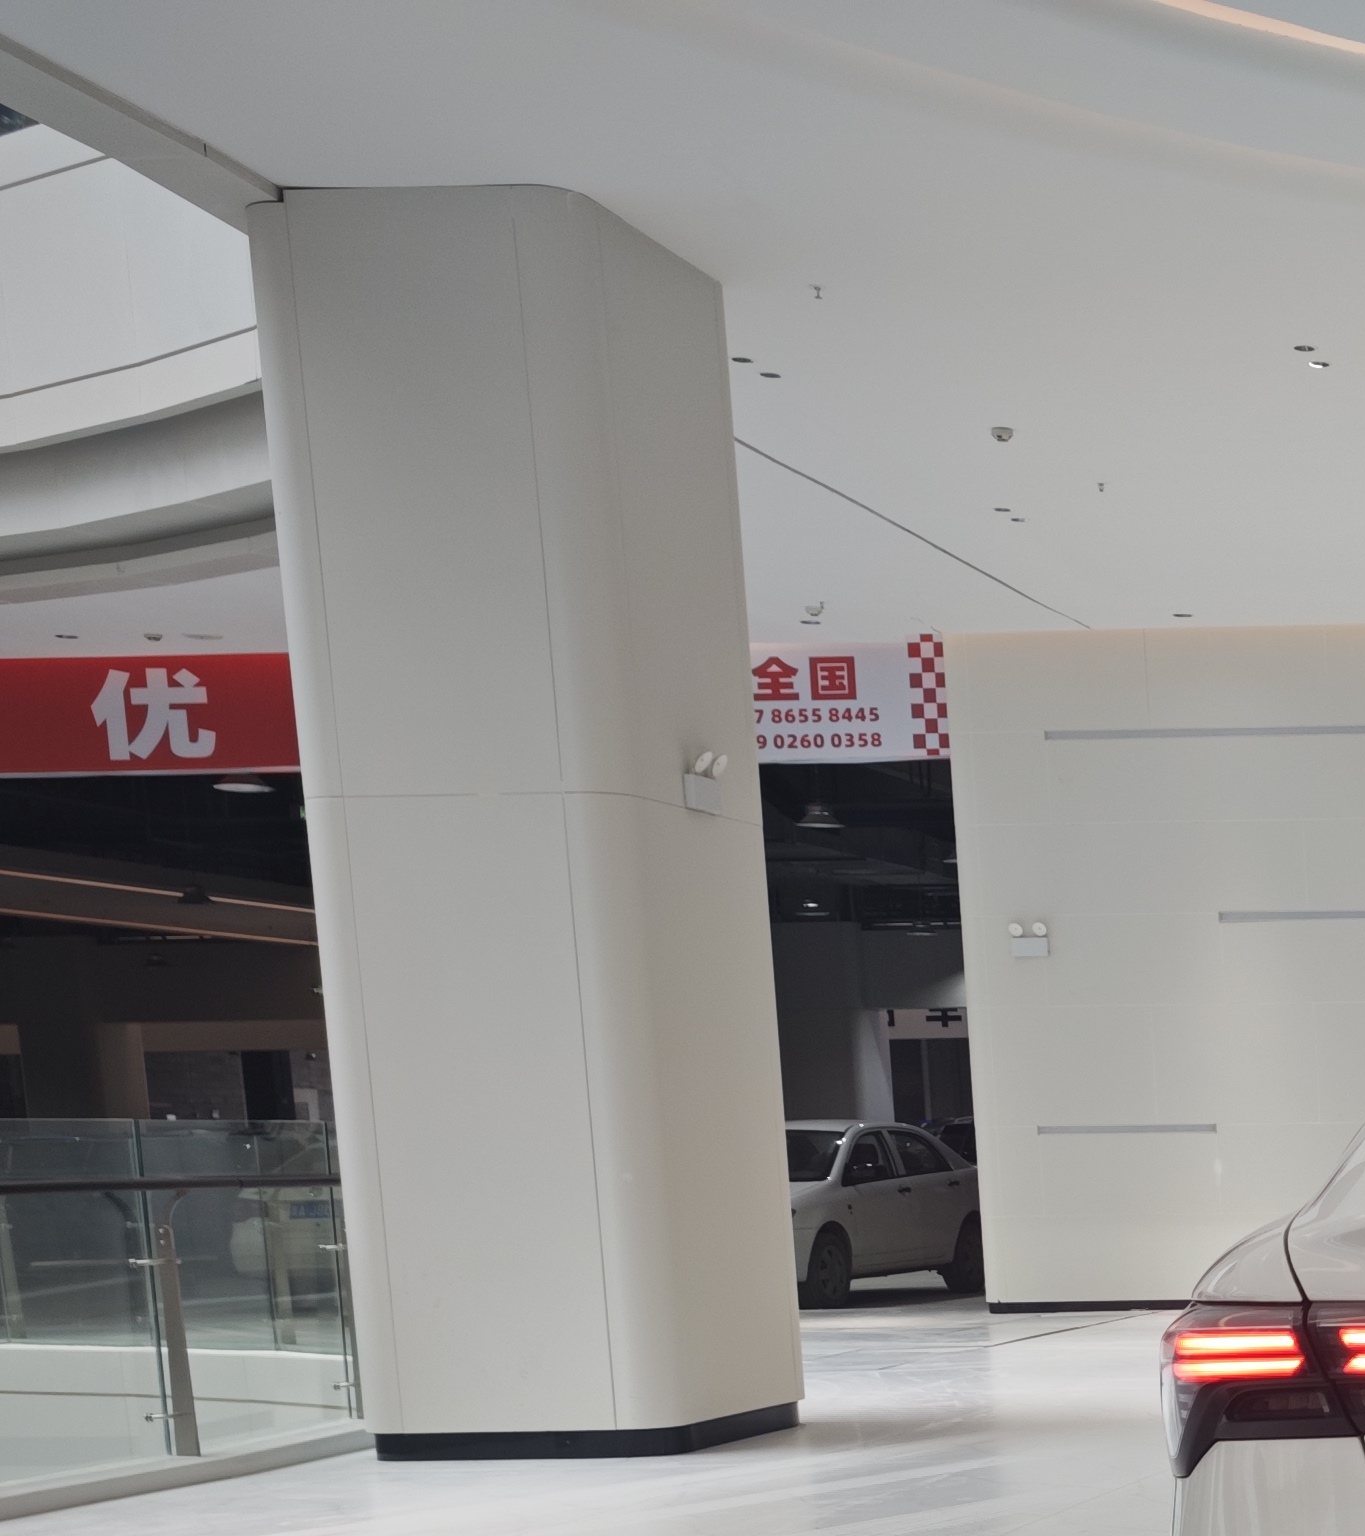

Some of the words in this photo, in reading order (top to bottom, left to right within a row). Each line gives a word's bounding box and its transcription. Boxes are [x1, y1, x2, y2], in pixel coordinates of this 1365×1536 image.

[90, 667, 217, 761] 优
[771, 708, 823, 724] 8655
[828, 707, 880, 722] 8445
[773, 733, 825, 750] 0260
[830, 732, 882, 748] 0358
